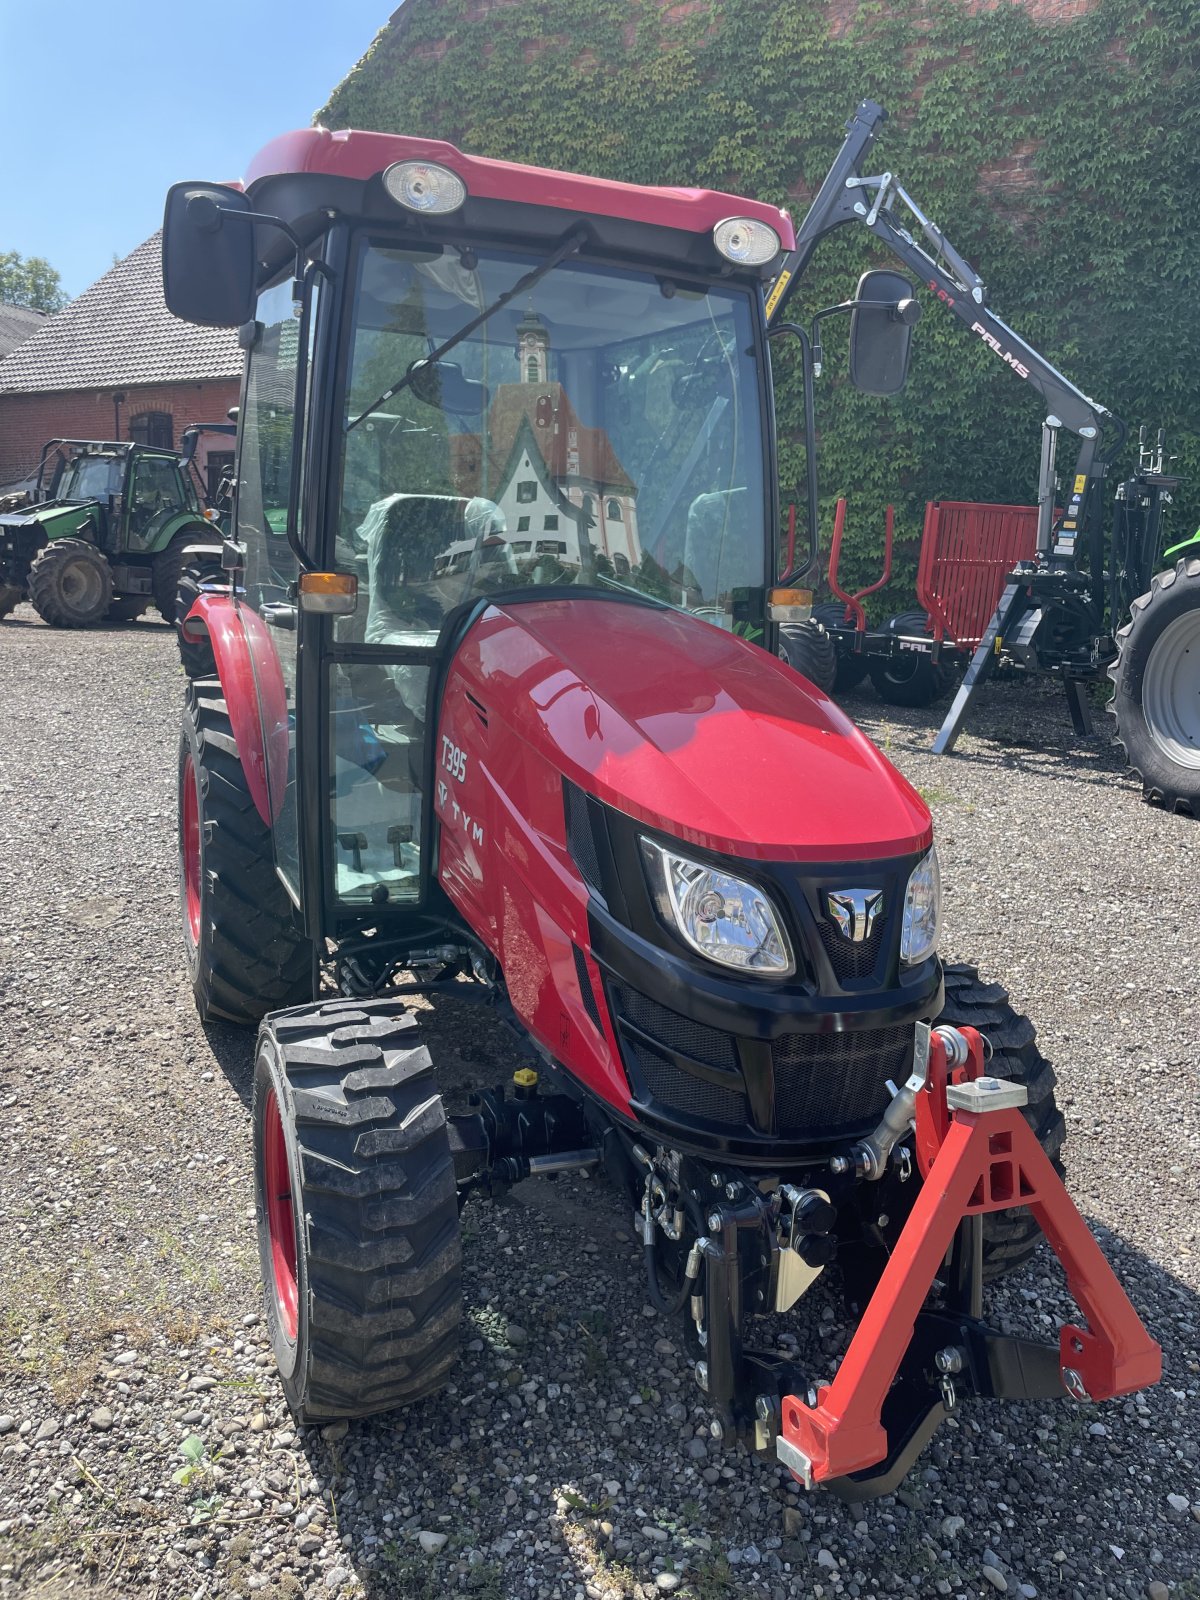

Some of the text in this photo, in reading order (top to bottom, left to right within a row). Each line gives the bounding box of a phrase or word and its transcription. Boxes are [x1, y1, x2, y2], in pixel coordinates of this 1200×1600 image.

[971, 321, 1030, 379] PALMS
[899, 642, 933, 654] PAL
[441, 734, 468, 784] T395
[452, 801, 484, 846] TYM
